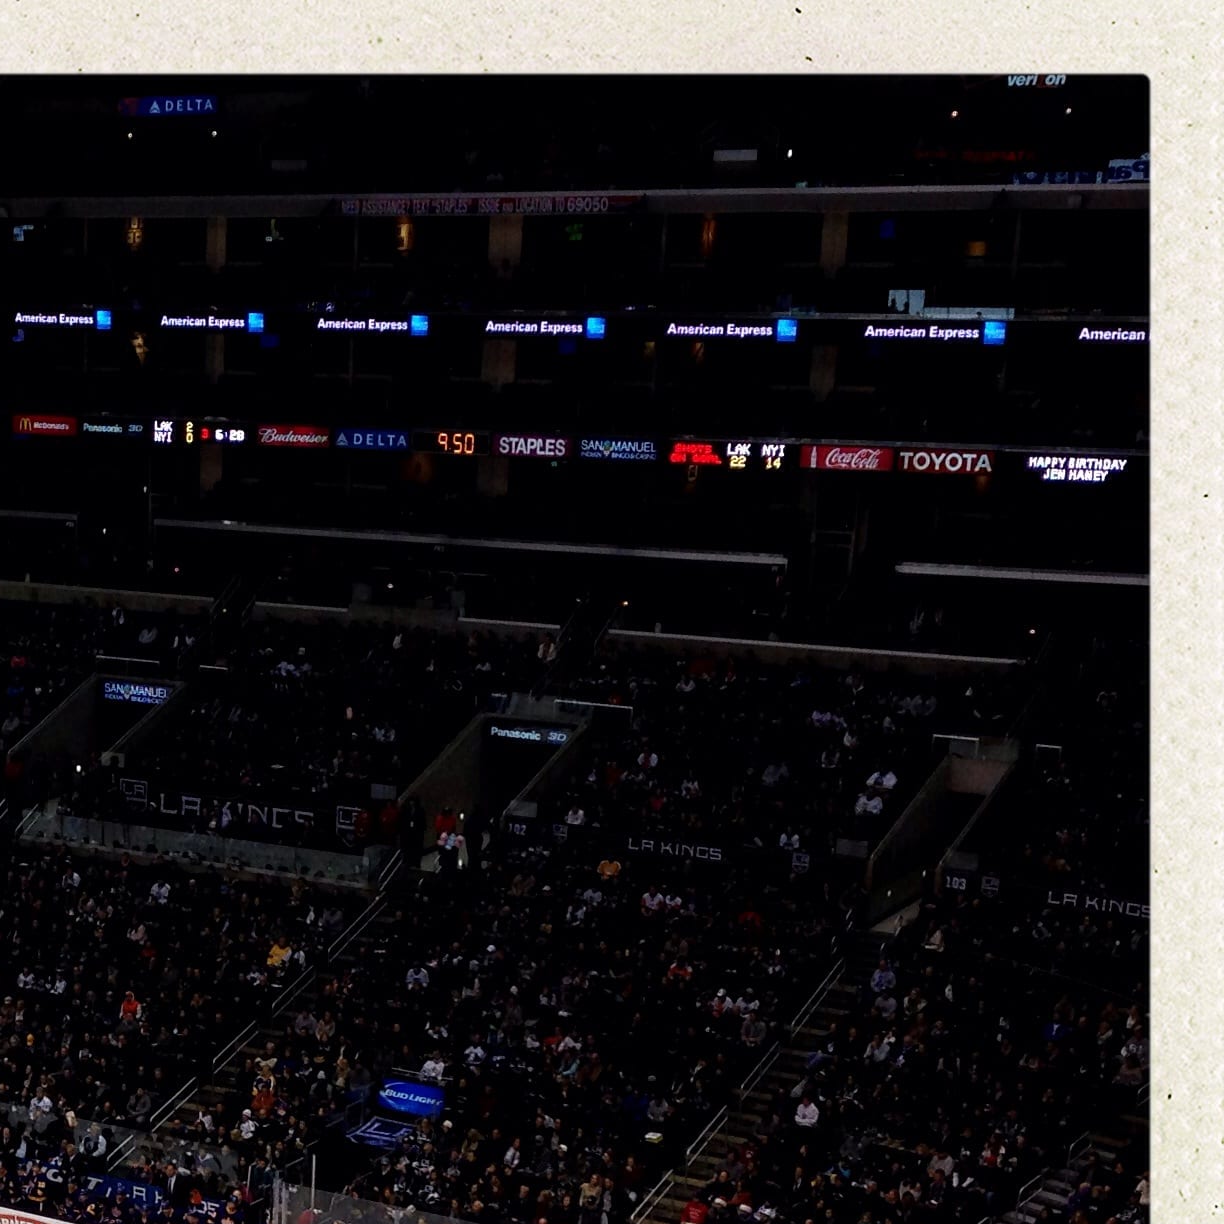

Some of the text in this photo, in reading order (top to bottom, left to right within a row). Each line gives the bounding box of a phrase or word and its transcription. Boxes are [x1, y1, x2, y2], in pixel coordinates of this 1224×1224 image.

[165, 99, 214, 112] DELTA
[567, 197, 609, 212] 69050
[15, 312, 94, 326] American Express
[161, 315, 245, 329] American Express
[317, 318, 408, 332] American Express
[485, 320, 583, 335] American Express
[667, 323, 773, 338] American Express
[864, 325, 979, 340] American Express
[1079, 328, 1146, 341] American
[83, 422, 123, 433] Panasonic
[154, 420, 173, 432] LAK
[154, 432, 172, 443] NYI
[259, 427, 328, 444] Budweiser
[353, 433, 407, 447] DELTA
[499, 436, 566, 456] STAPLES
[581, 440, 656, 453] SAN MANUEL
[727, 443, 785, 457] LAK NYI
[729, 456, 781, 469] 22 14
[899, 451, 992, 472] TOYOTA
[1028, 456, 1127, 471] HAPPY BIRTHDAY
[1043, 469, 1108, 482] JEN HANEY
[490, 726, 568, 743] Panasonic 3D
[628, 837, 722, 861] LA KINGS
[1048, 890, 1078, 907] LA
[385, 1088, 408, 1100] BUD
